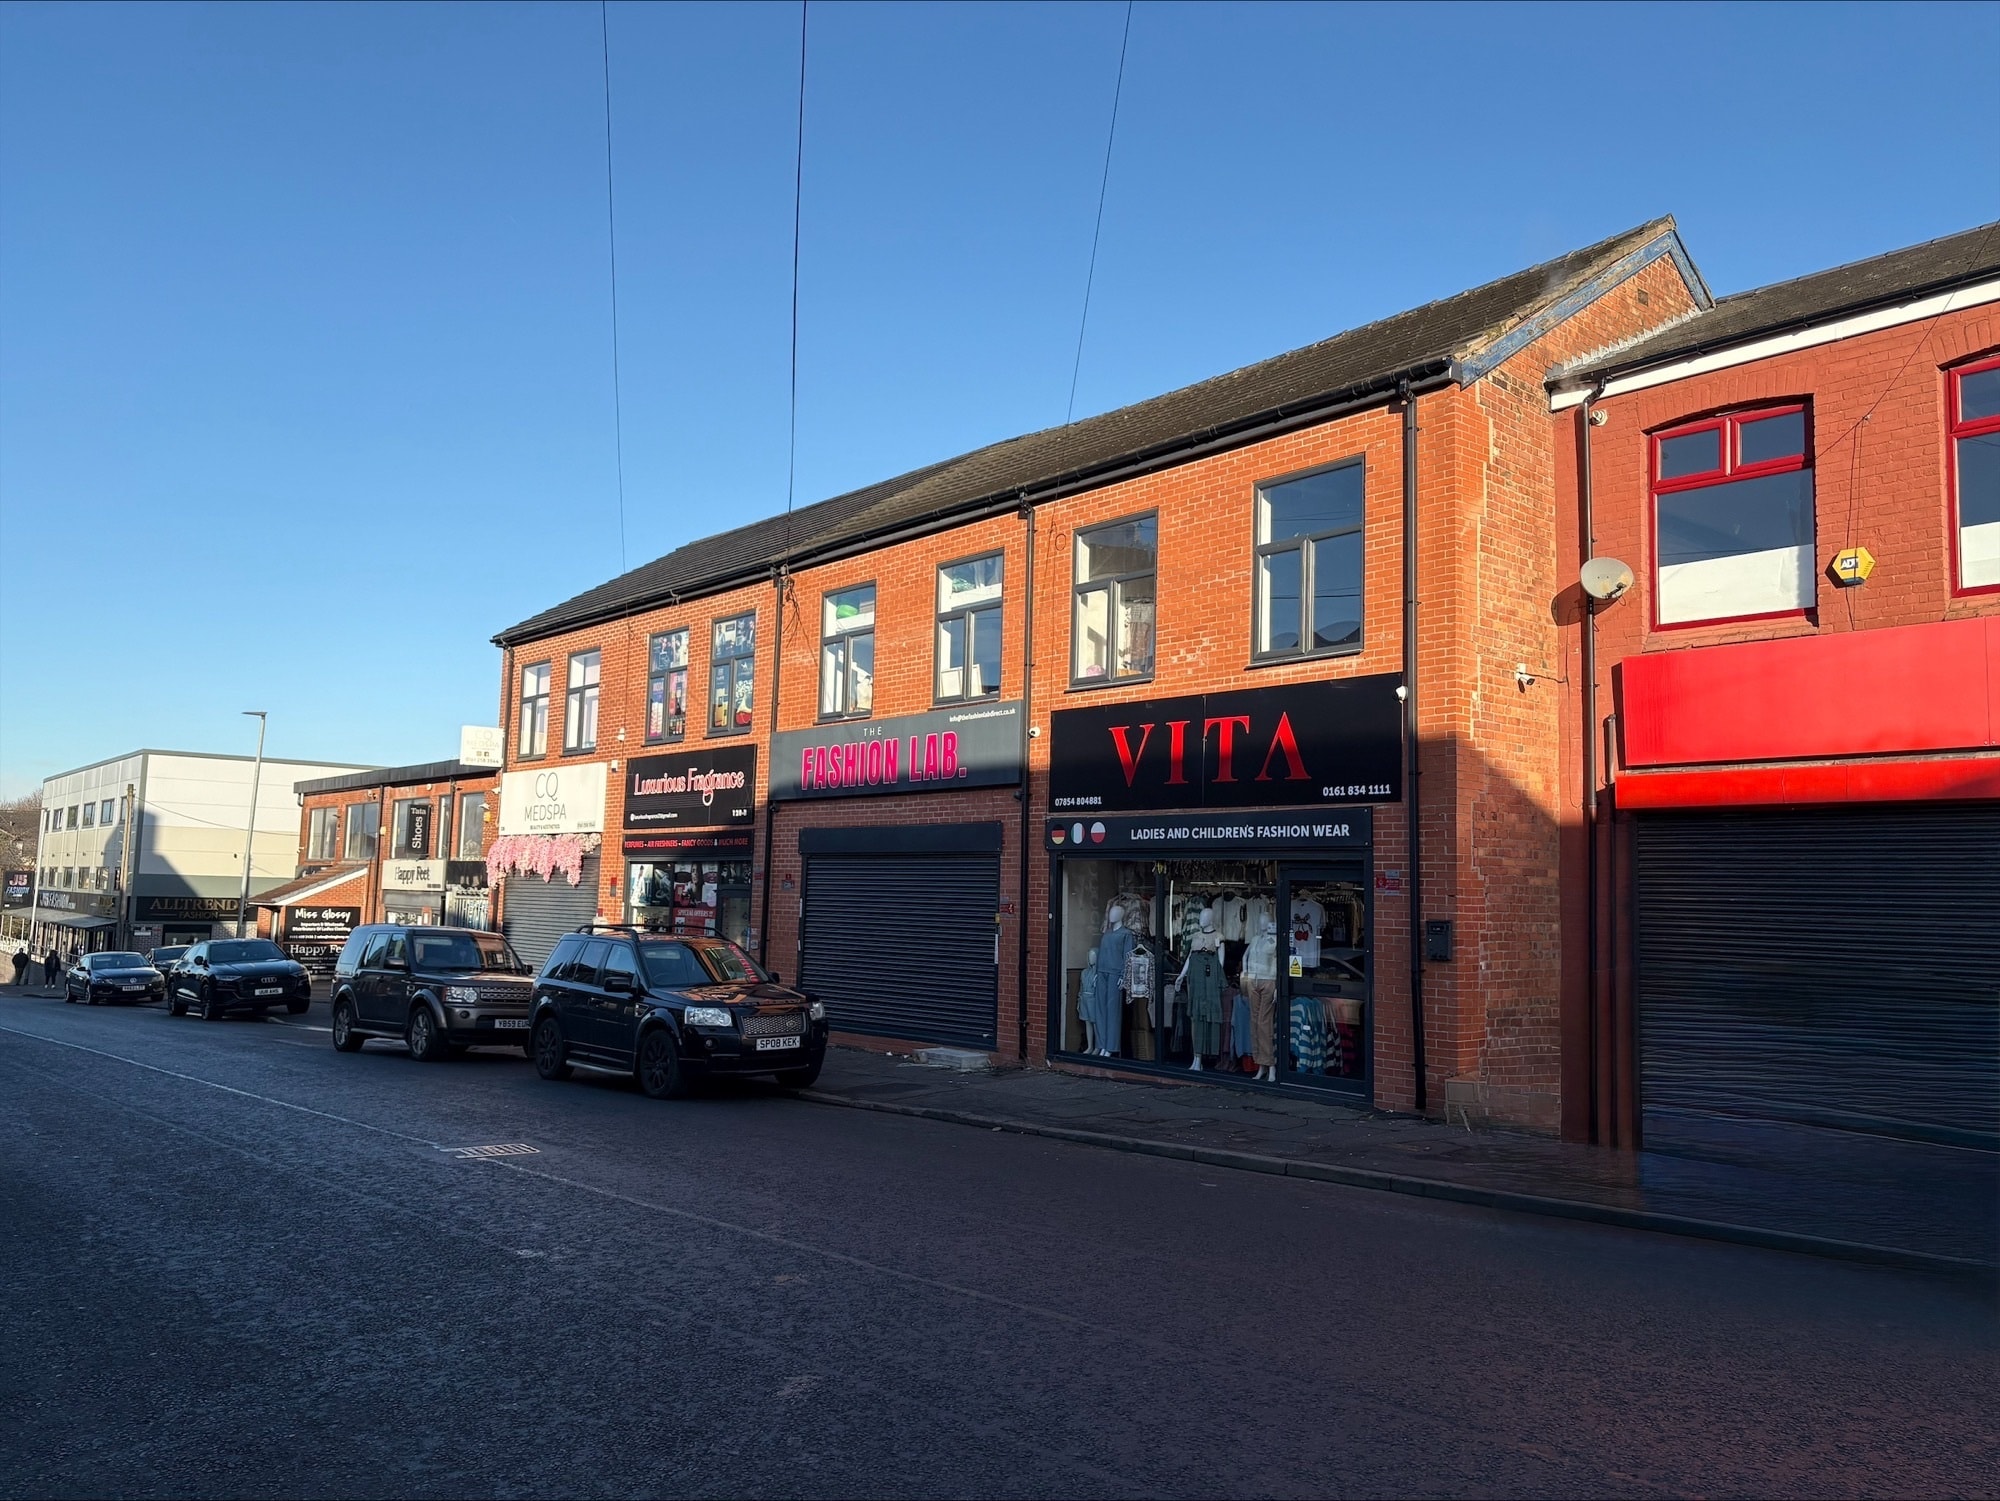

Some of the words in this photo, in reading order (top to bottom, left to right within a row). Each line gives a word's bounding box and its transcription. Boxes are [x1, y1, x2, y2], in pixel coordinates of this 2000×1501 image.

[863, 726, 882, 736] THE
[1108, 711, 1312, 788] VITA
[802, 738, 899, 791] FASHION
[535, 772, 559, 801] CQ
[634, 773, 686, 796] Luxurious
[687, 768, 745, 806] Fragrance
[1323, 786, 1346, 796] 0161
[1347, 785, 1366, 795] 834
[1368, 784, 1391, 794] 1111
[1055, 798, 1075, 806] 07854
[1076, 796, 1102, 805] 804881
[410, 807, 427, 815] Tata
[524, 803, 567, 821] MEDSPA
[412, 816, 423, 849] Shoes
[1131, 828, 1165, 840] LADIES
[1167, 827, 1189, 839] AND
[1191, 825, 1254, 839] CHILDREN'S
[1257, 825, 1309, 838] FASHION
[1313, 824, 1350, 836] WEAR
[150, 898, 239, 911] ALLTREND
[179, 911, 218, 919] FASHION
[295, 908, 317, 919] Miss
[321, 908, 351, 923] Glossy
[290, 944, 327, 956] Happy
[760, 1039, 781, 1049] SP08
